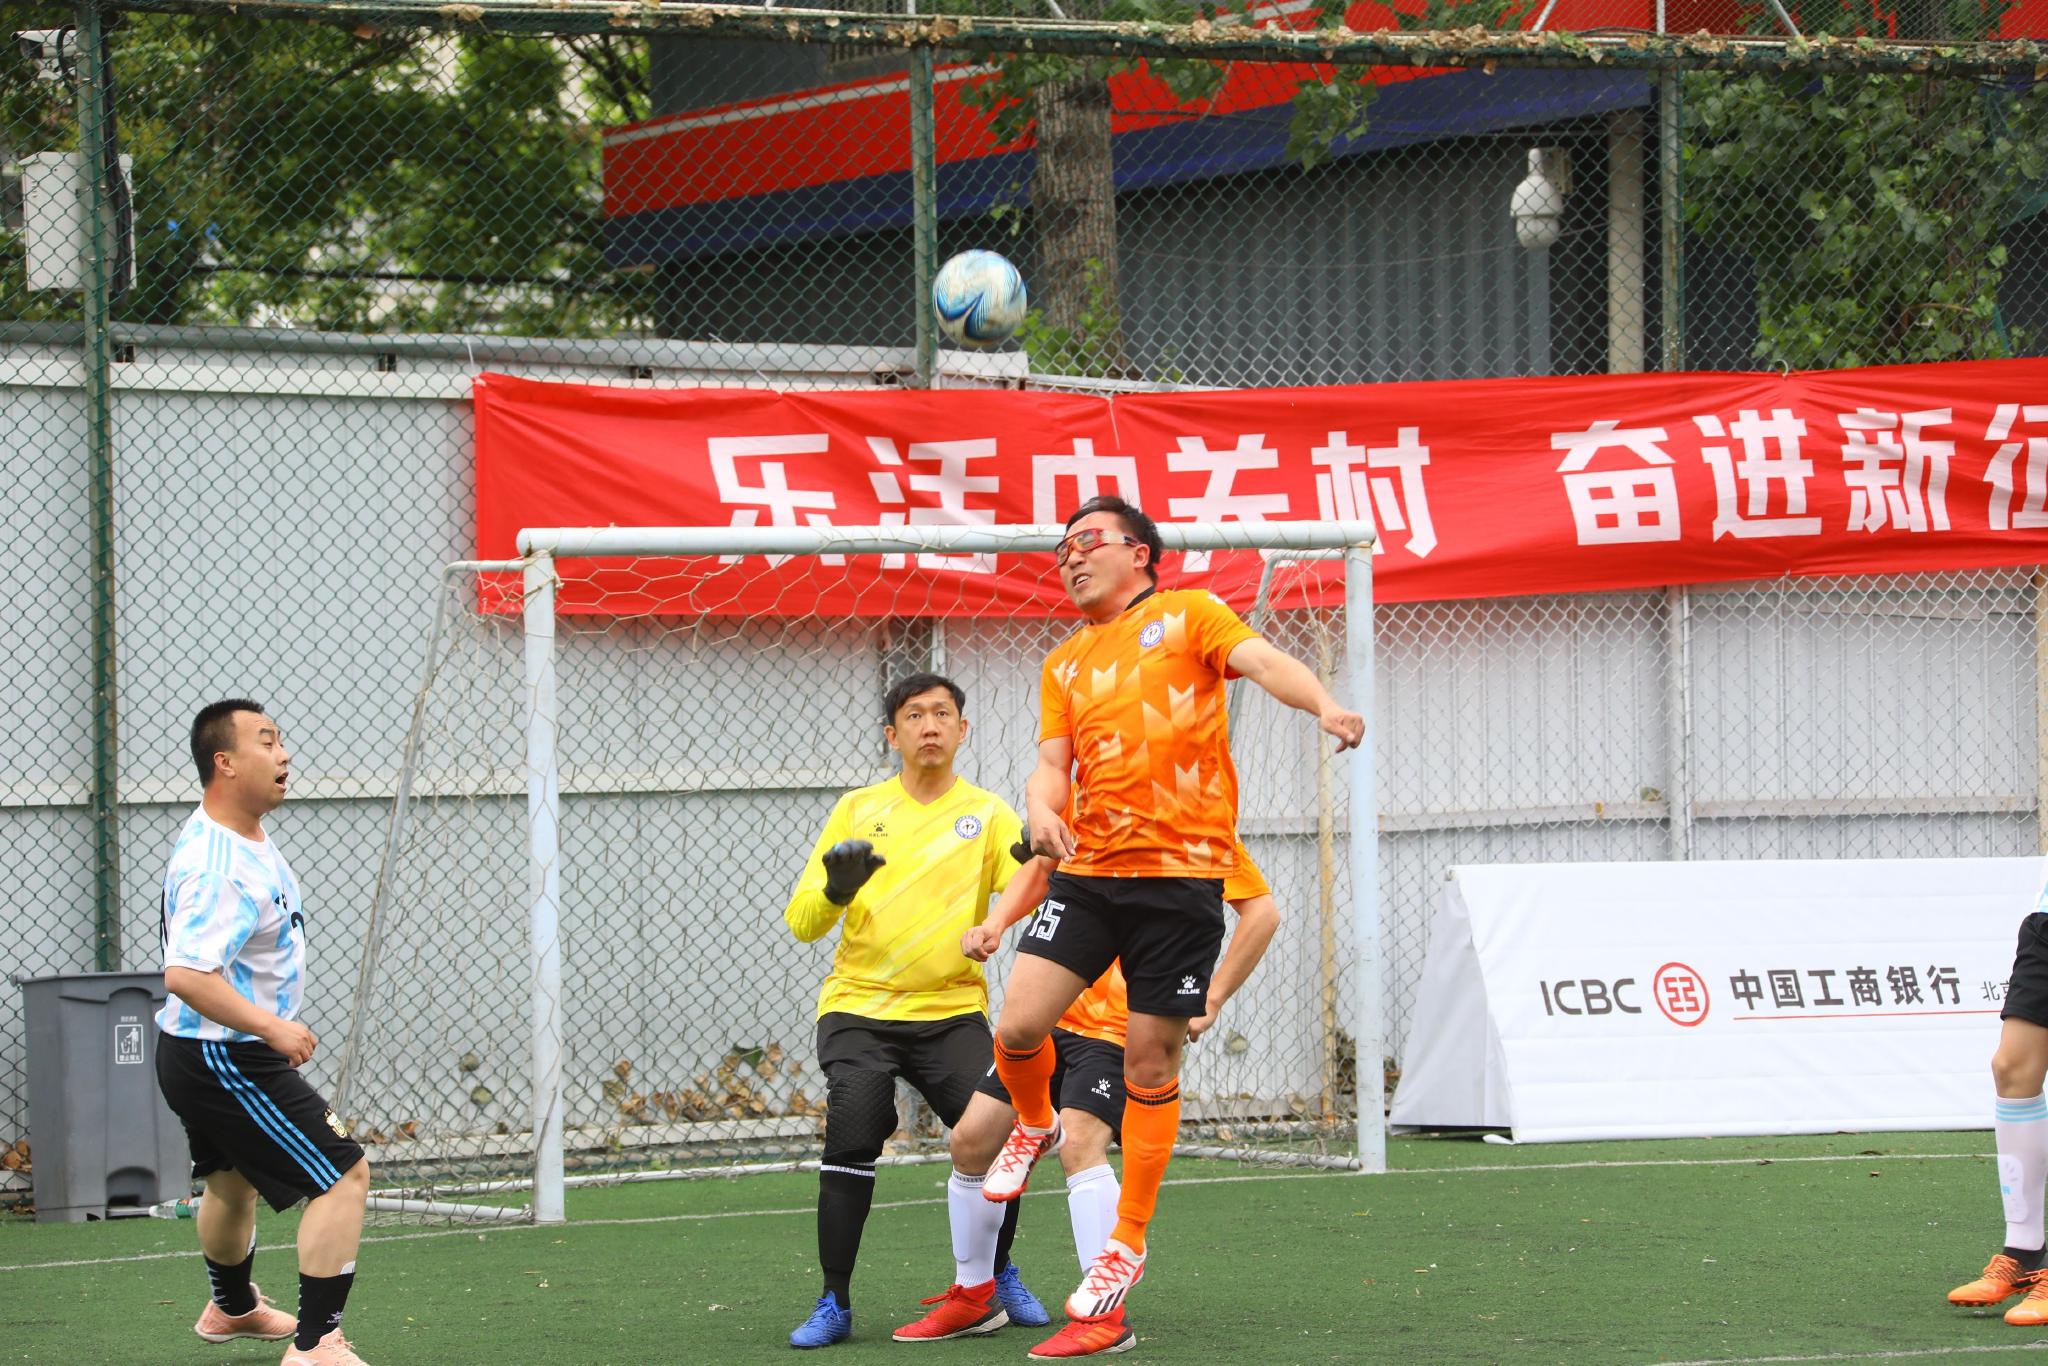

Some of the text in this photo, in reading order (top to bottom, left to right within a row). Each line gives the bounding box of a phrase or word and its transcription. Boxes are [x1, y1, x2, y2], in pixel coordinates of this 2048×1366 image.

[1028, 899, 1065, 941] 15
[1540, 978, 1642, 1016] ICBC
[1729, 965, 1962, 1010] 中国工商银行
[1091, 1087, 1111, 1099] KELME
